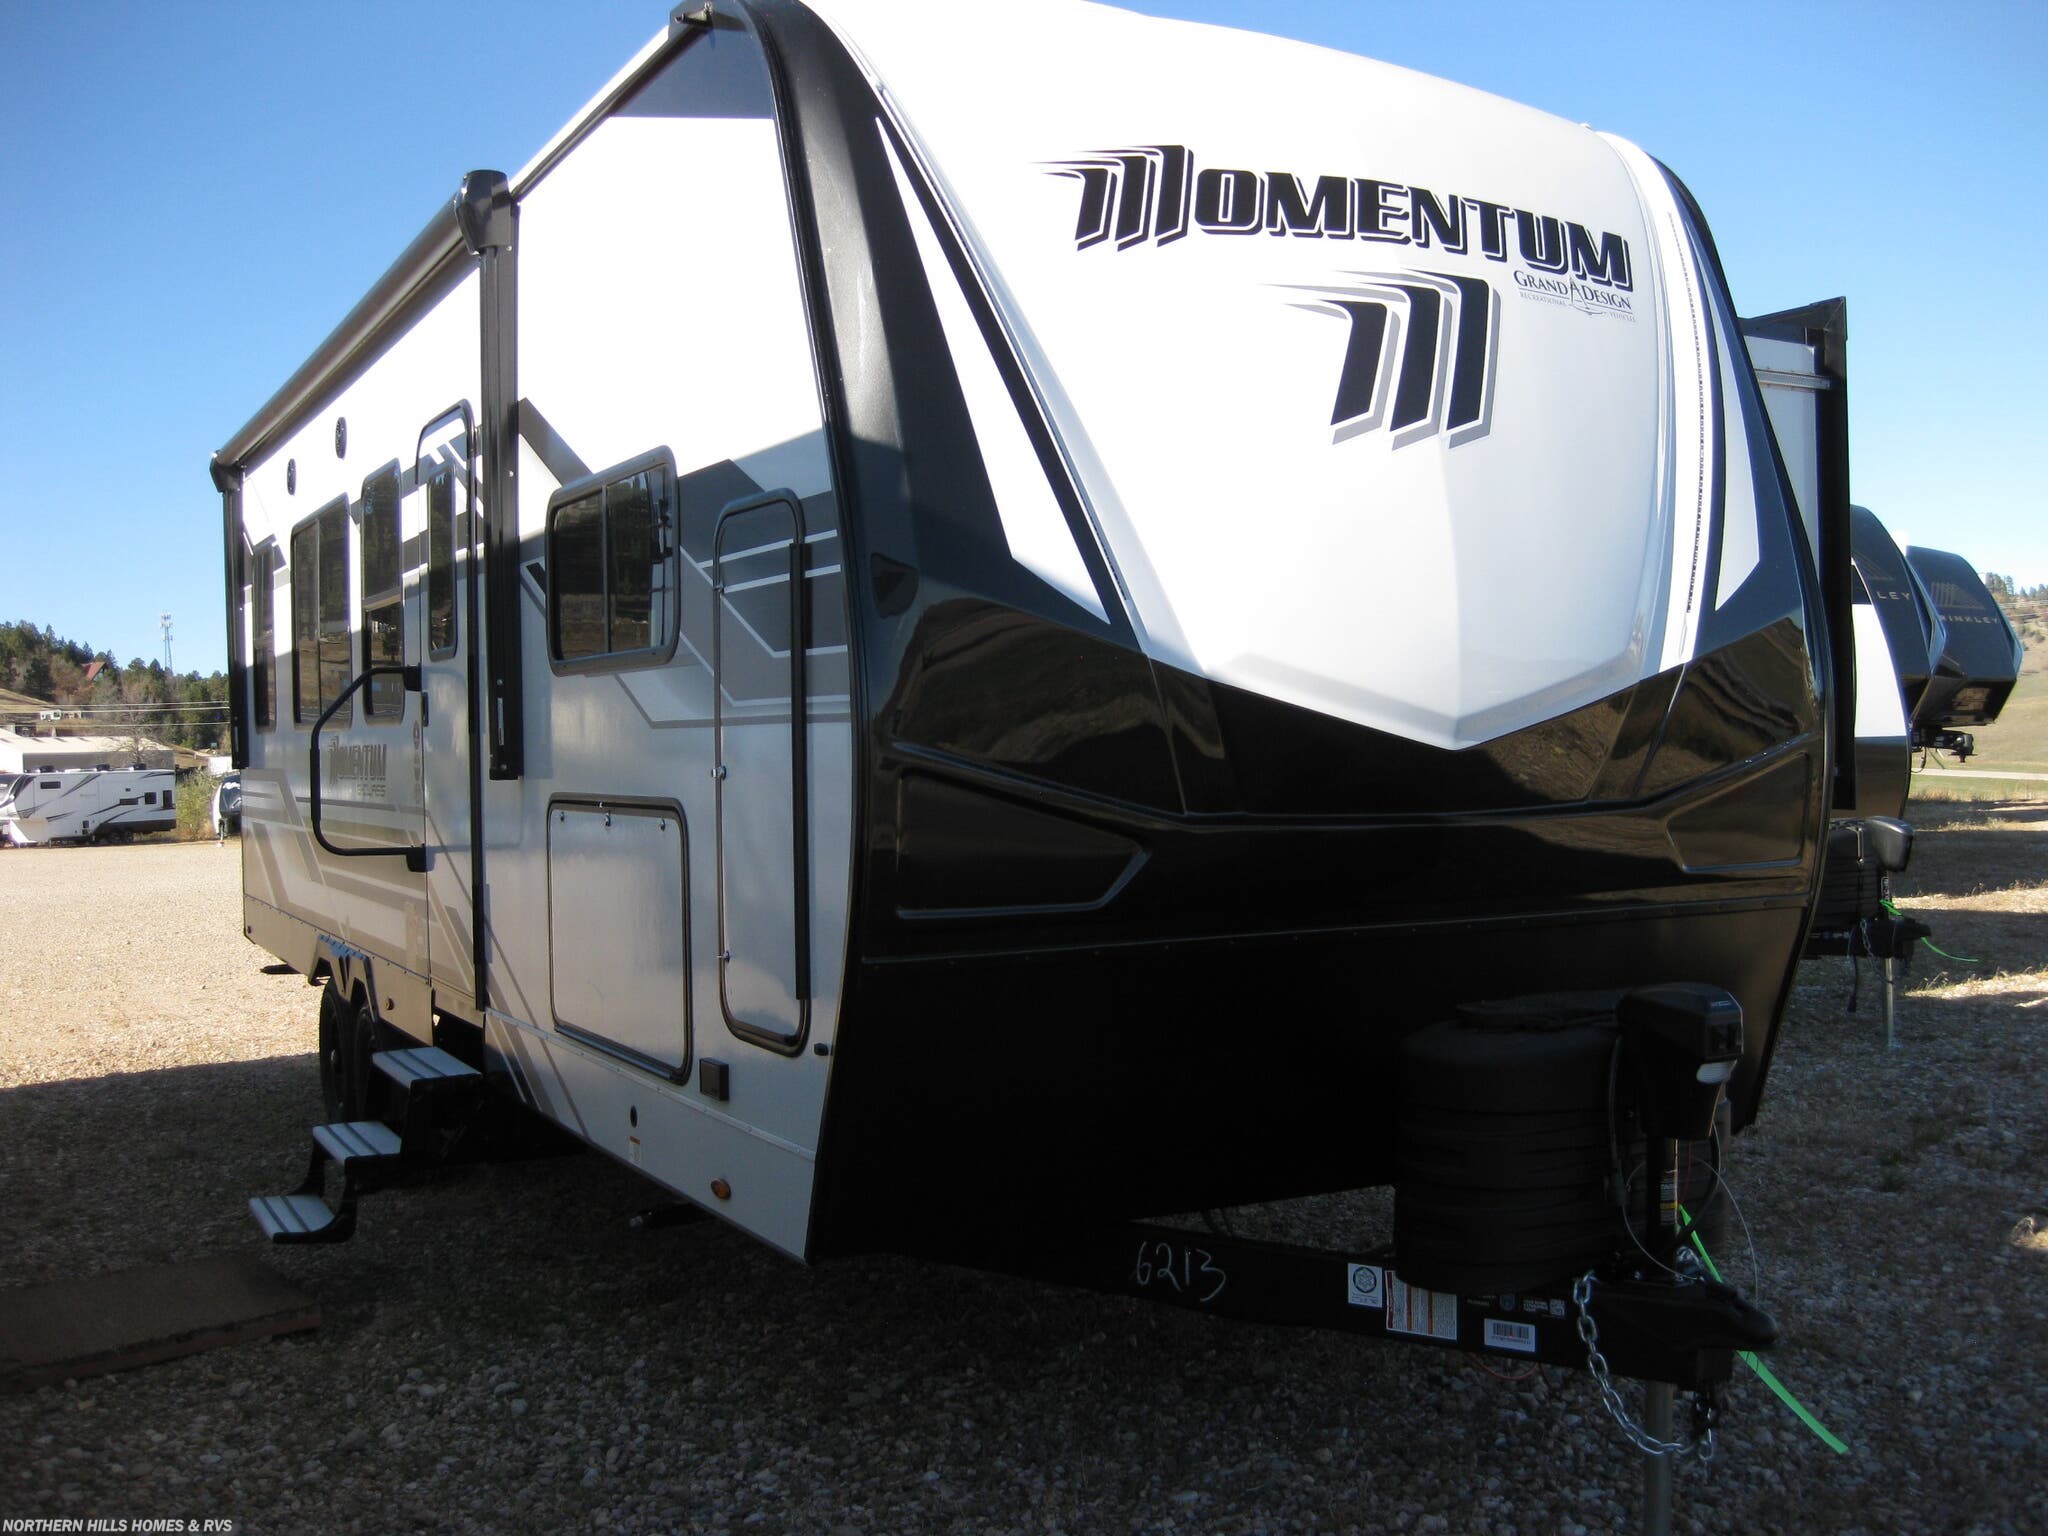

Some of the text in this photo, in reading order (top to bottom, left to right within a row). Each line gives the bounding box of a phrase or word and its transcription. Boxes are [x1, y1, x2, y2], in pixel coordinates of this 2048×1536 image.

[1030, 145, 1634, 292] MOMENTUM
[1513, 270, 1632, 310] GRAND DESIGN
[1876, 591, 1910, 600] LEY
[1136, 1241, 1227, 1302] 6213
